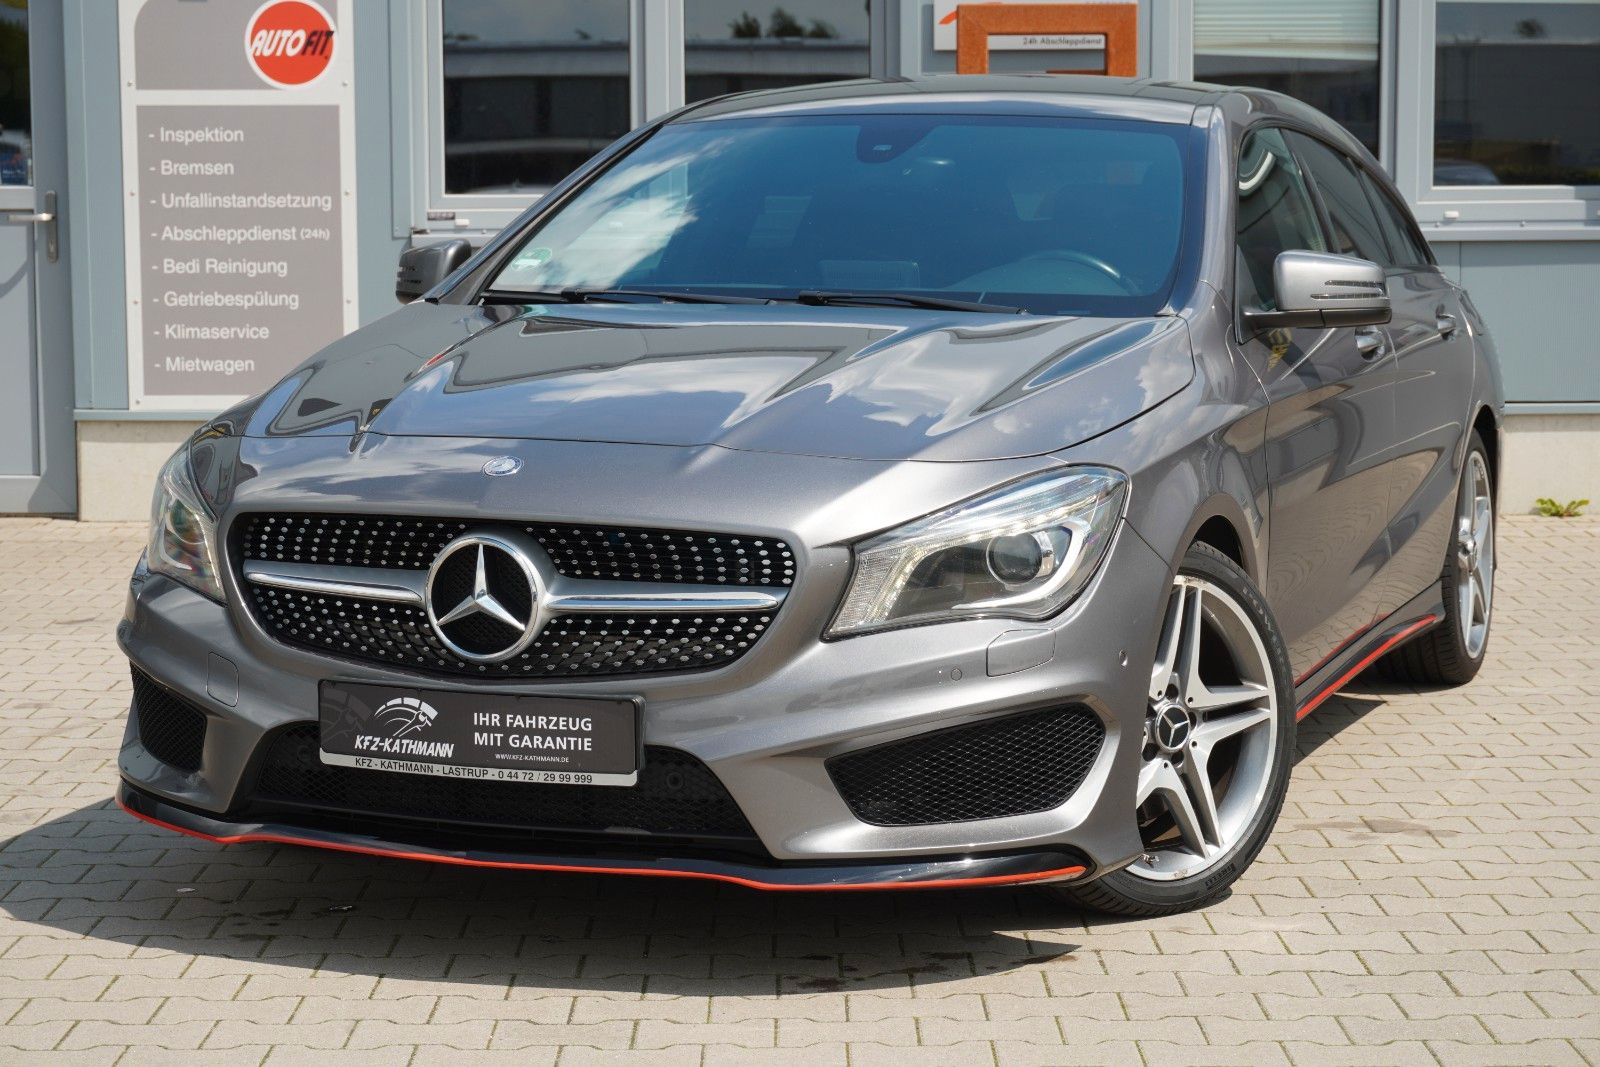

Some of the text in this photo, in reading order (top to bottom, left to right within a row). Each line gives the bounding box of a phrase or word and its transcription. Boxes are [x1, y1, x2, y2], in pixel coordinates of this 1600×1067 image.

[251, 29, 334, 57] AUTOFIT
[160, 127, 244, 145] Inspektion
[161, 159, 234, 175] Bremsen
[162, 193, 332, 211] Unfallinstandsetzung
[161, 226, 297, 244] Abschleppdienst
[300, 229, 330, 241] (24h)
[163, 258, 200, 274] Bedi
[206, 258, 288, 277] Reinigung
[164, 291, 299, 309] Getriebespülung
[165, 324, 269, 339] Klimaservice
[166, 357, 255, 375] Mietwagen
[473, 712, 592, 731] IHR FAHRZEUG
[354, 735, 454, 758] KFZ-KATHMANN
[474, 732, 592, 751] MIT GARANTIE
[495, 753, 569, 763] WWW.KFZ-KATHMANN.DE
[355, 757, 372, 768] KFZ
[380, 760, 434, 774] KATHMANN
[442, 766, 489, 778] LASTRUP
[498, 770, 504, 779] 0
[507, 771, 519, 780] 44
[522, 772, 534, 781] 72
[543, 773, 556, 782] 29
[559, 774, 571, 783] 99
[574, 774, 593, 783] 999
